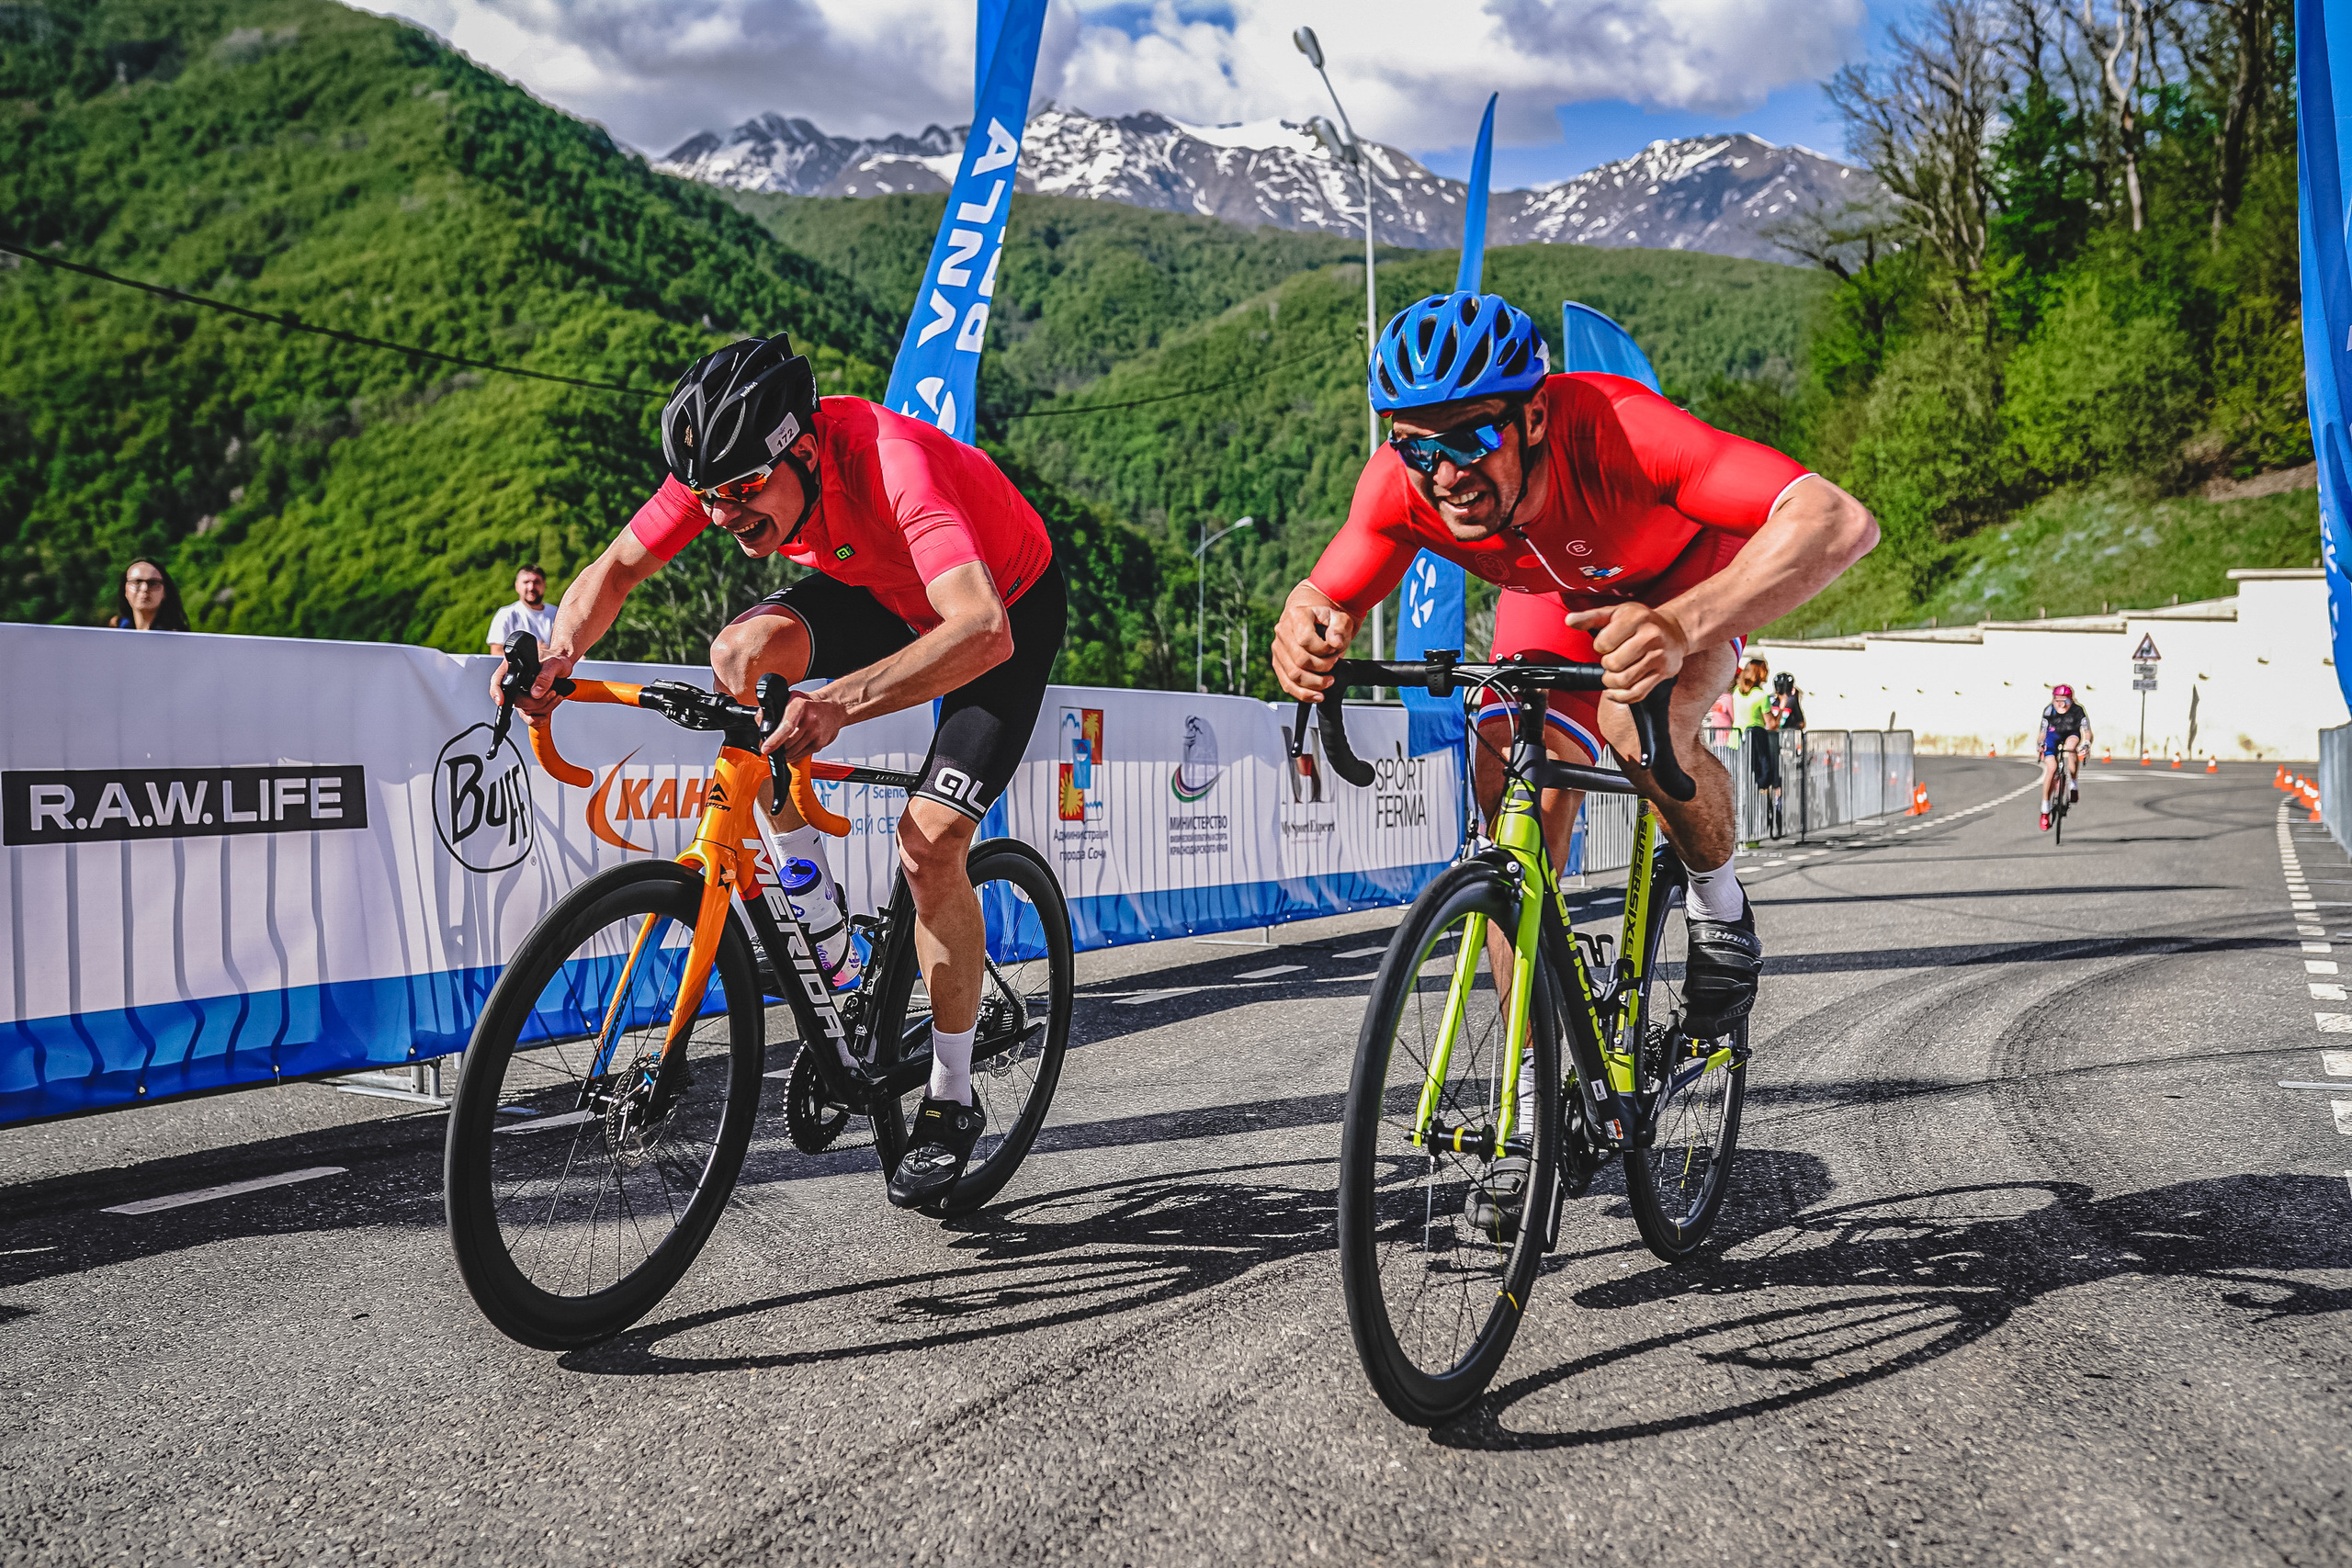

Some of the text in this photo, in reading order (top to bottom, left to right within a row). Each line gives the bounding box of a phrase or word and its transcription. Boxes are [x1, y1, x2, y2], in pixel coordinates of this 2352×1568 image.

[776, 427, 794, 448] 172
[223, 777, 344, 823] LIFE
[615, 778, 713, 821] КАН
[873, 785, 910, 799] Scienc
[1170, 815, 1227, 830] МИНИСТЕРСТВО
[1377, 794, 1427, 829] FERMA
[1053, 829, 1109, 842] Администрация
[1059, 847, 1106, 863] города Сочи
[1625, 818, 1650, 959] SUPERSIXE
[741, 838, 845, 1039] MERIDA
